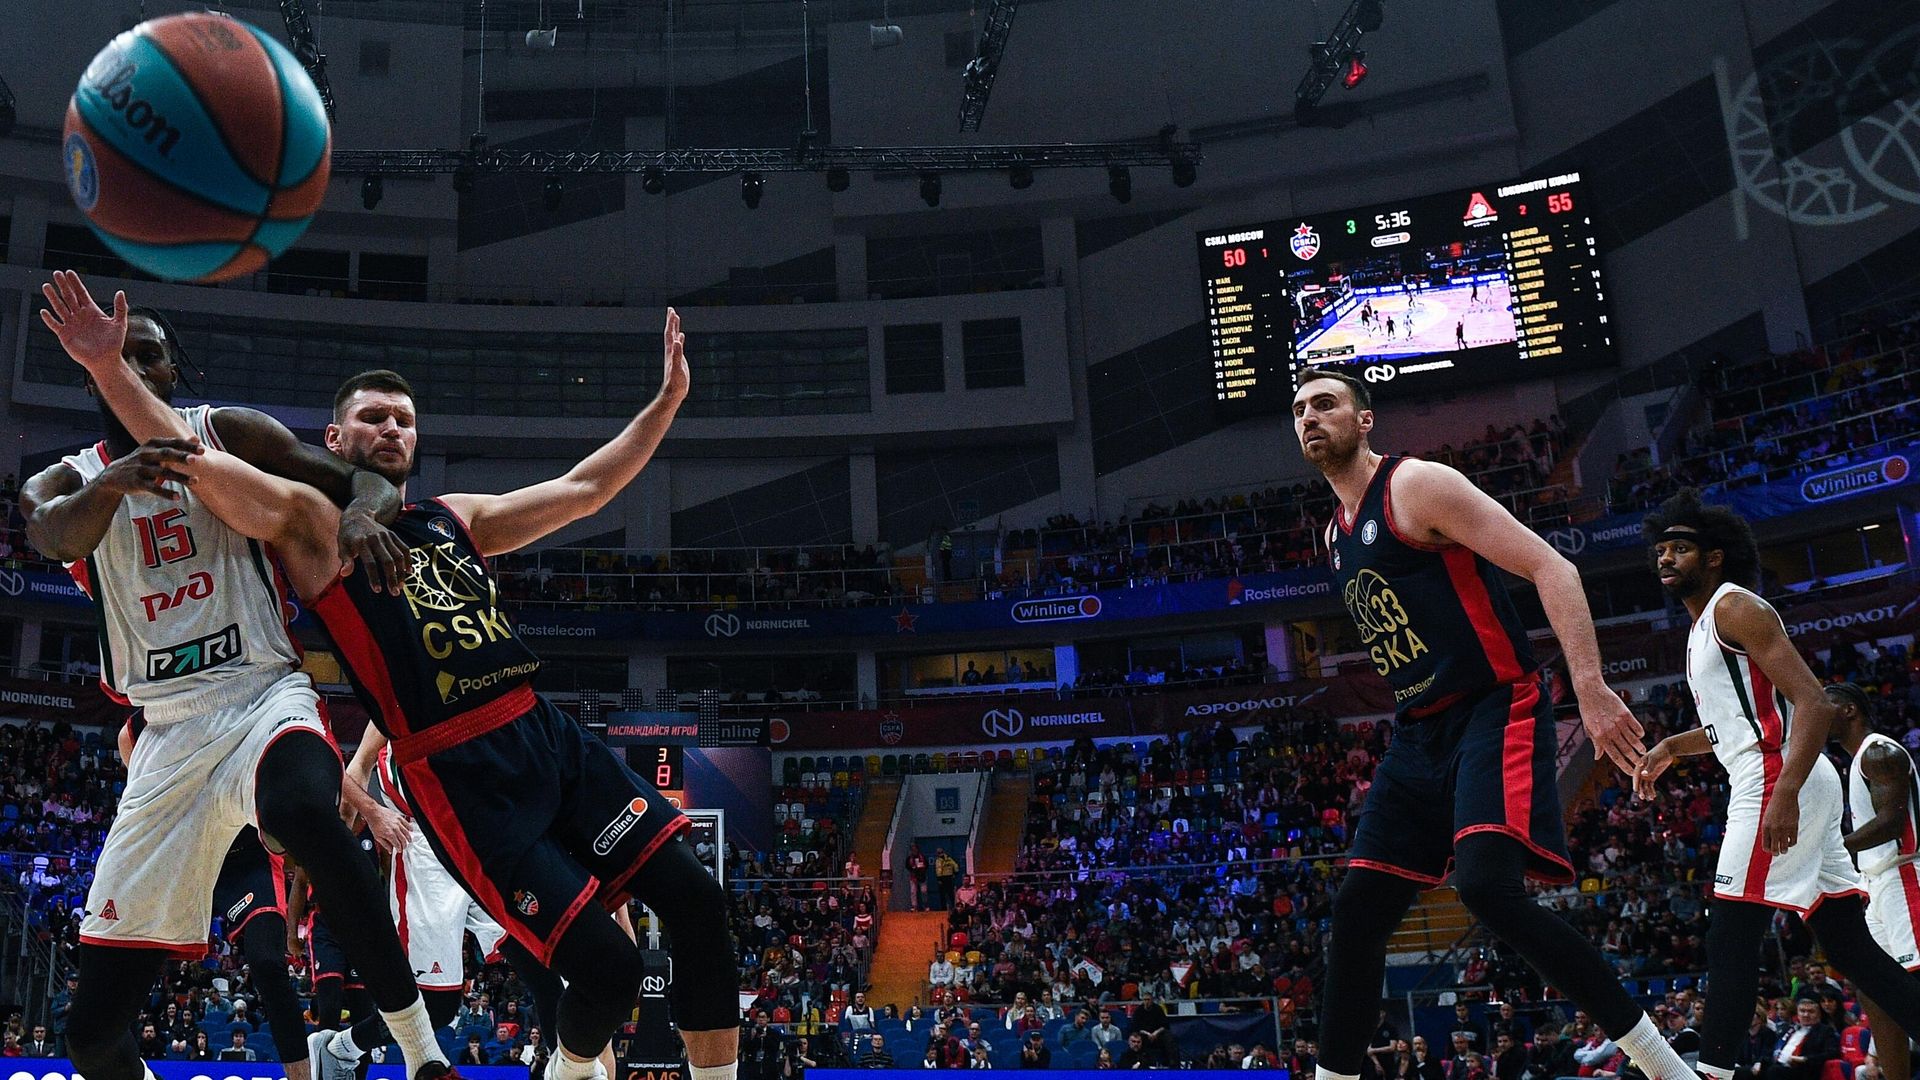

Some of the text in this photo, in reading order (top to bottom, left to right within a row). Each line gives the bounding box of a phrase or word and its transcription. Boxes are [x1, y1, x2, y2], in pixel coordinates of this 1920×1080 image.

[1519, 205, 1527, 215] 2
[1548, 192, 1572, 213] 55
[1346, 220, 1356, 234] 3
[1375, 211, 1411, 230] 5:36
[1205, 230, 1264, 246] CSKA MOSCOW
[1294, 237, 1317, 247] CSKA
[1224, 248, 1246, 268] 50
[1262, 248, 1267, 258] 1
[1213, 339, 1220, 347] 15
[1810, 469, 1877, 496] Winline
[132, 508, 197, 568] 15
[1592, 524, 1642, 543] NORNIC
[30, 582, 86, 597] NORNICK
[1244, 582, 1330, 601] Rostelecom
[1019, 603, 1076, 618] Winline
[1371, 588, 1409, 633] 33
[746, 619, 810, 630] NORNICKEL
[1786, 605, 1898, 637] ЭРОФЛОТ
[518, 623, 596, 637] Rostelecom
[1370, 628, 1429, 677] SKA
[1, 691, 76, 709] NORNICKEL
[1185, 695, 1297, 717] АЭРОФЛОТ
[1030, 712, 1105, 726] NORNICKEL
[607, 723, 698, 736] НАСЛАЖДАЙСЯ ИГРОЙ
[722, 724, 761, 738] nline
[658, 748, 667, 762] 3
[657, 765, 670, 786] 8
[598, 814, 634, 850] Winline
